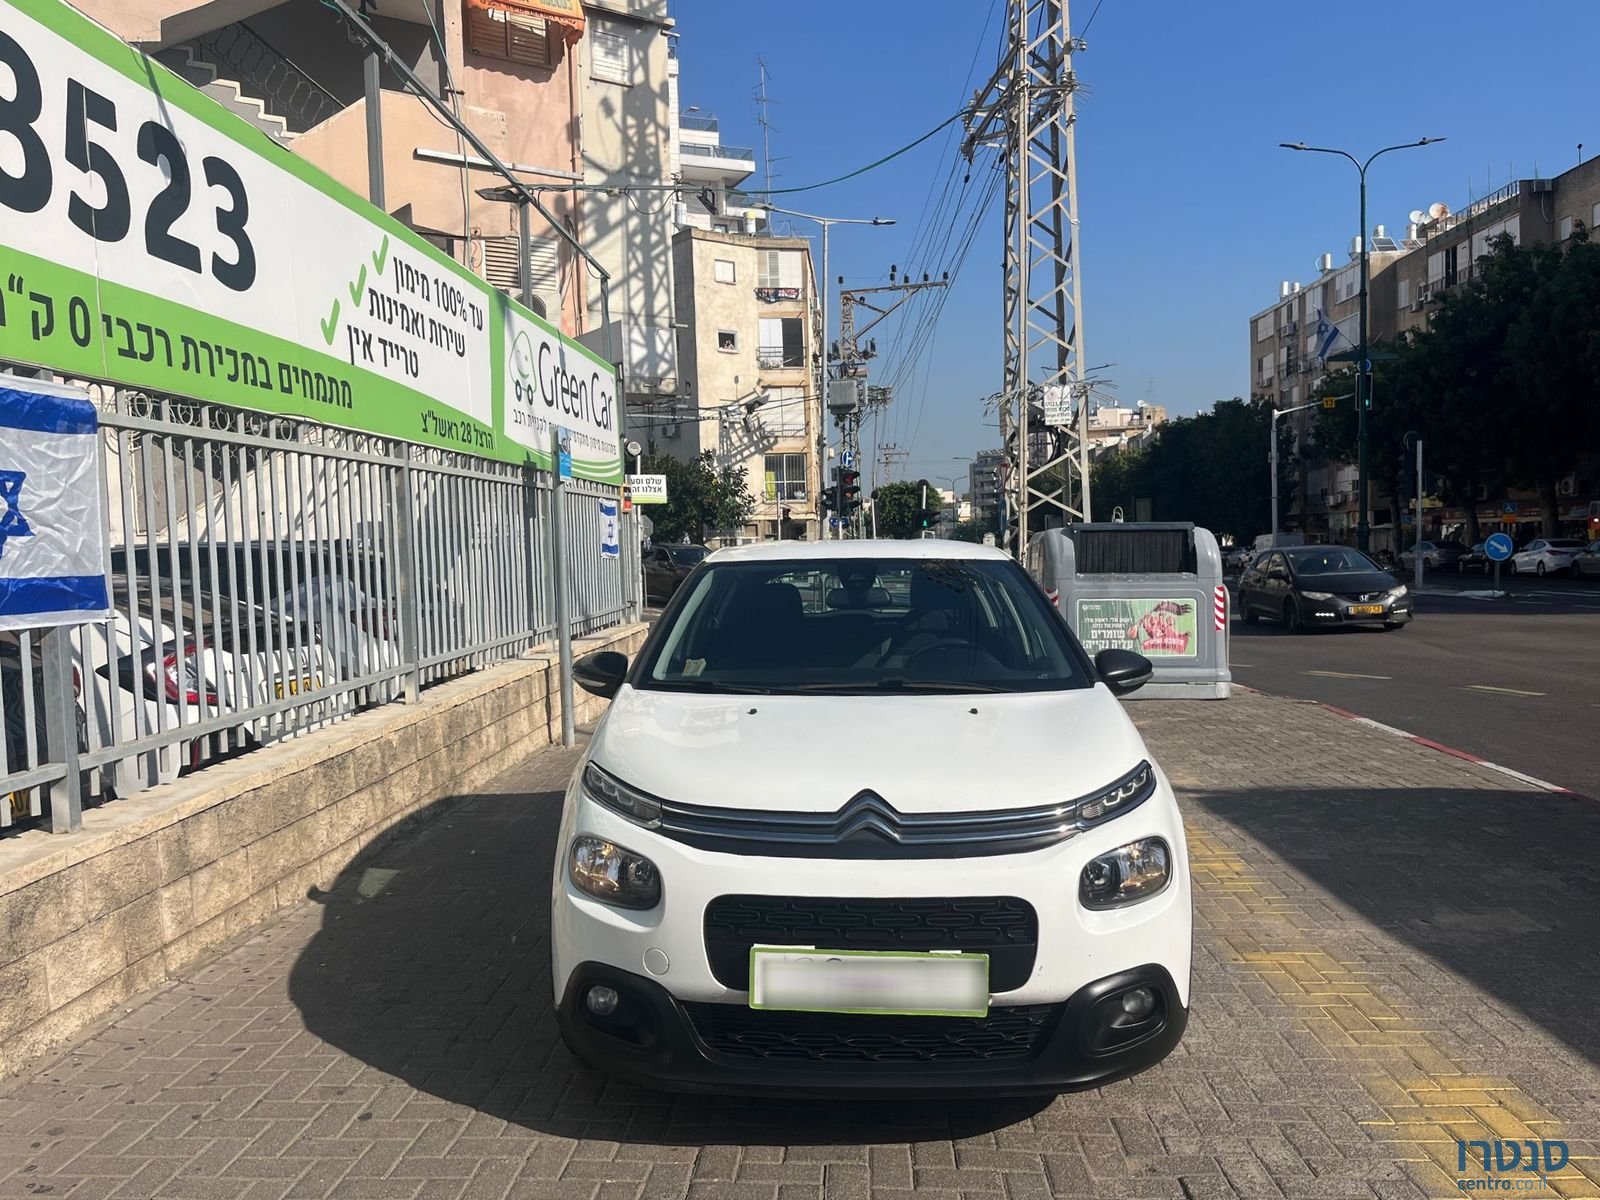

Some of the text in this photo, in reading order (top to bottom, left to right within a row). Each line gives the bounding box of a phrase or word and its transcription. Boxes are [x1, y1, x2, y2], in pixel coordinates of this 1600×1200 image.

[393, 256, 483, 331] עד 100% מימון
[69, 296, 91, 347] 0
[102, 313, 173, 367] רכבי
[368, 288, 465, 357] שירות ואמינות
[181, 334, 273, 391] במכירת
[347, 324, 419, 378] טרייד אין
[278, 362, 352, 409] מתמחים
[538, 341, 613, 432] Green Car
[461, 421, 472, 444] 28
[473, 423, 493, 450] הרצל
[513, 408, 526, 426] רכב
[642, 485, 663, 493] אצלנו
[645, 477, 662, 485] שלם
[1091, 630, 1125, 639] שומרים
[1111, 639, 1134, 650] עליה
